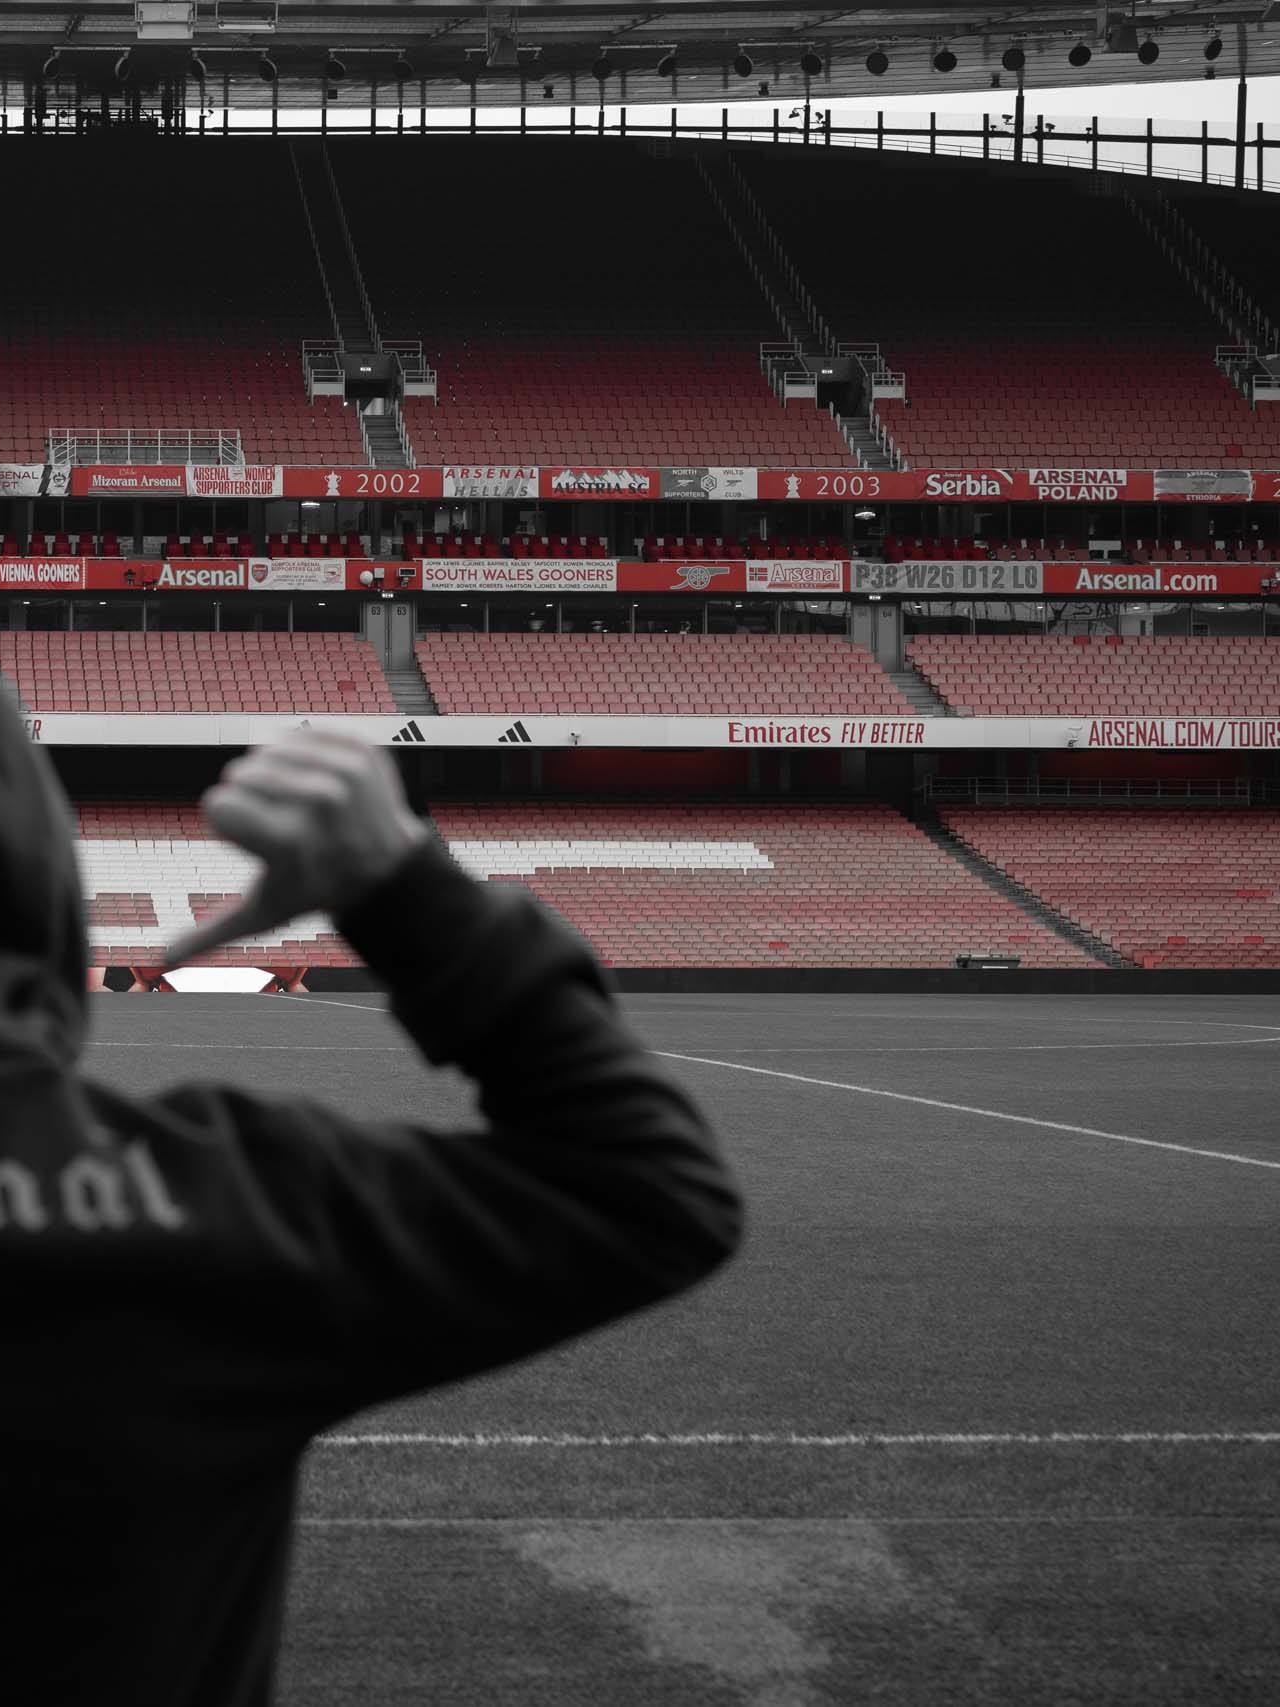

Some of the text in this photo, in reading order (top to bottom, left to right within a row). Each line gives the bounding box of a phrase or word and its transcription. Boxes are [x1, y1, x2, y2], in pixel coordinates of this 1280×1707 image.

[92, 475, 181, 487] Mizoram Arsenal
[193, 467, 276, 481] ARSENAL WOMEN
[445, 469, 537, 479] ARSENAL
[1033, 470, 1123, 484] ARSENAL
[196, 481, 273, 495] SUPPORTERS CLUB
[357, 473, 420, 494] 2002
[553, 482, 624, 495] AUSTRIA
[816, 476, 881, 497] 2003
[926, 474, 1001, 496] Serbia
[454, 486, 529, 497] HELLAS
[1038, 486, 1119, 501] POLAND
[0, 564, 80, 583] VIENNA GOONERS
[158, 563, 245, 586] Arsenal
[426, 568, 614, 581] SOUTH WALES GOONERS
[770, 564, 841, 582] Arsenal
[855, 564, 898, 589] P38
[905, 564, 955, 589] W26
[962, 565, 1005, 589] D12
[1075, 568, 1218, 591] Arsenal.com
[371, 606, 381, 616] 63
[397, 606, 407, 616] 63
[728, 720, 925, 743] Emirates FLY BETTER
